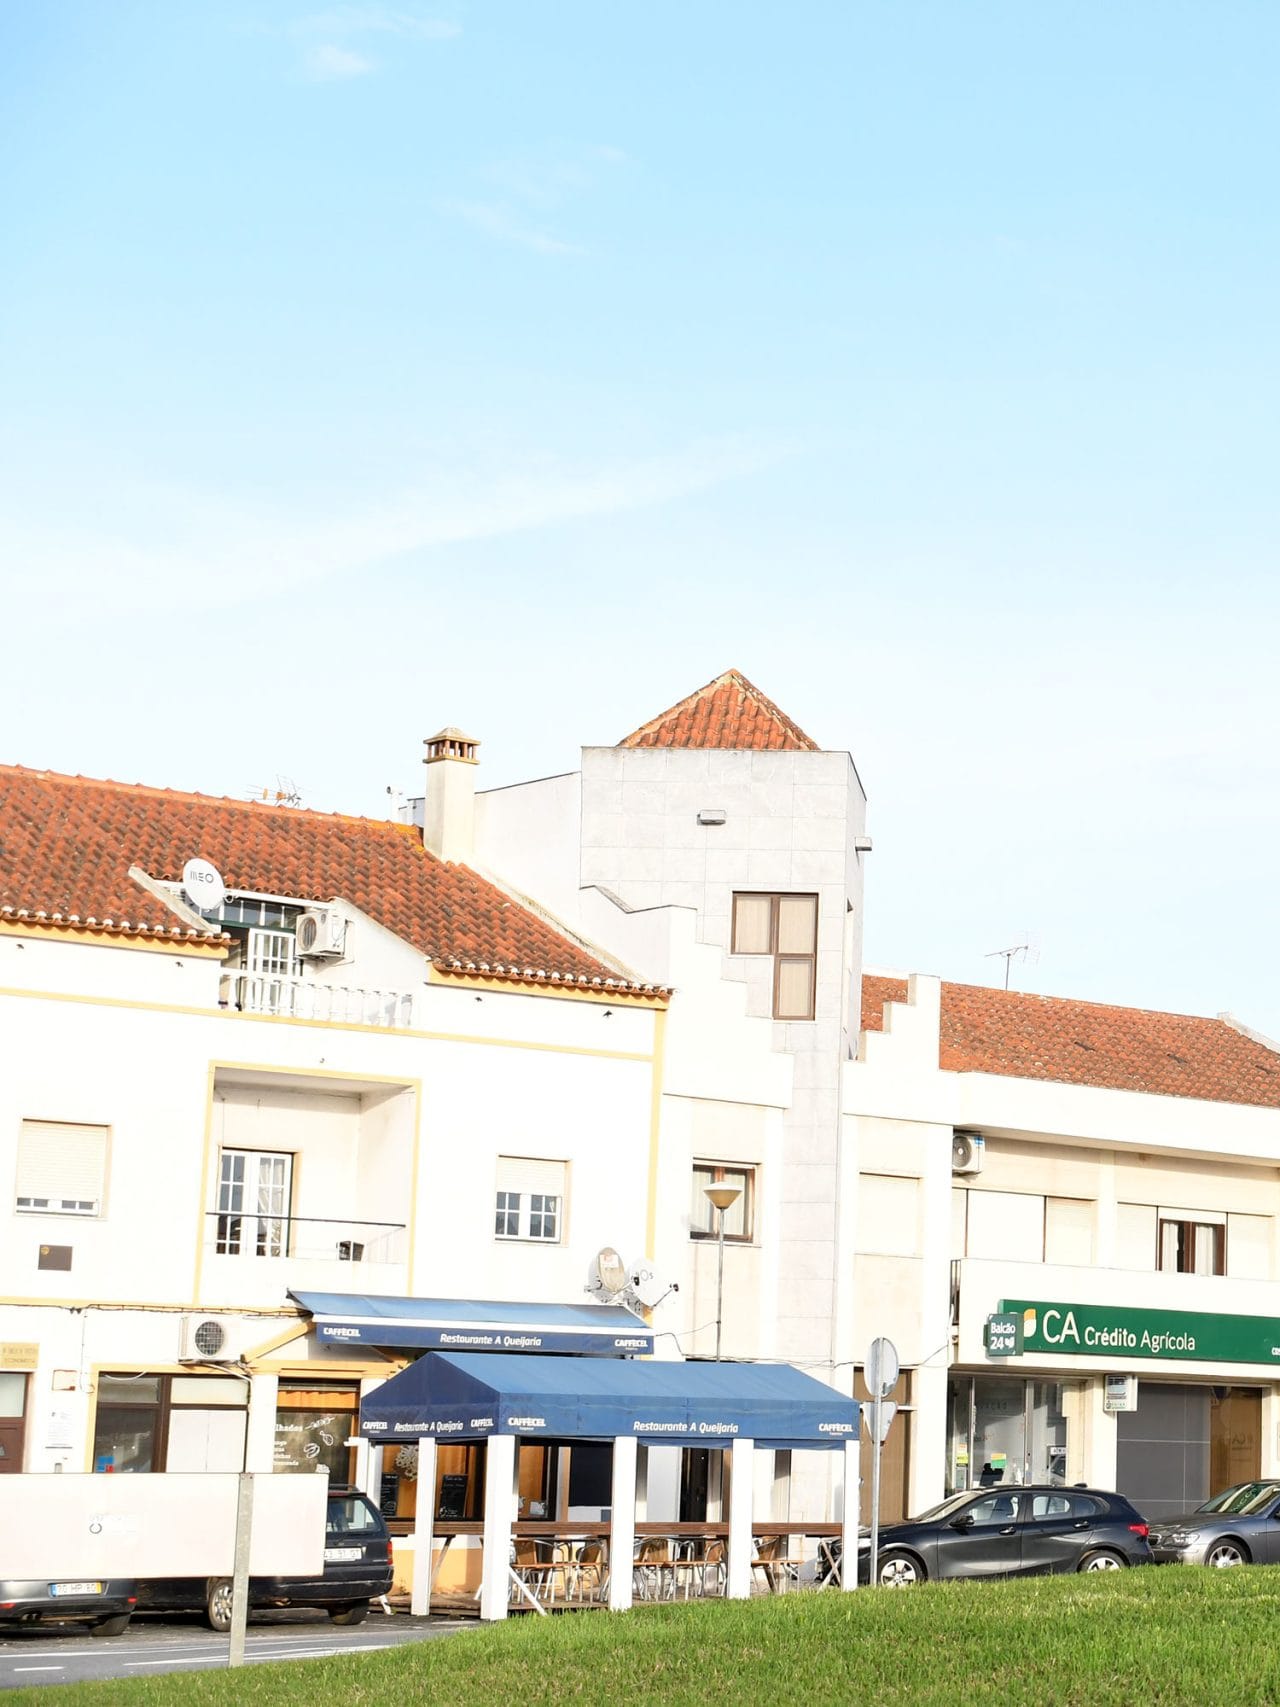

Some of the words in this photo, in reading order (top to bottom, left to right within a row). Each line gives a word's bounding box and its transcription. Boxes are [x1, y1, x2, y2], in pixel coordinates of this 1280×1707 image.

[990, 1322, 1016, 1334] Balcão
[1042, 1310, 1080, 1344] CA
[1084, 1326, 1137, 1346] Crédito
[1140, 1330, 1196, 1352] Agrícola
[440, 1333, 492, 1345] Restaurante
[494, 1336, 501, 1345] A
[503, 1336, 542, 1348] Queijaria
[394, 1422, 429, 1432] Restaurante
[429, 1422, 435, 1431] A
[633, 1421, 687, 1432] Restaurante
[690, 1422, 697, 1432] A
[699, 1422, 739, 1435] Queijaria
